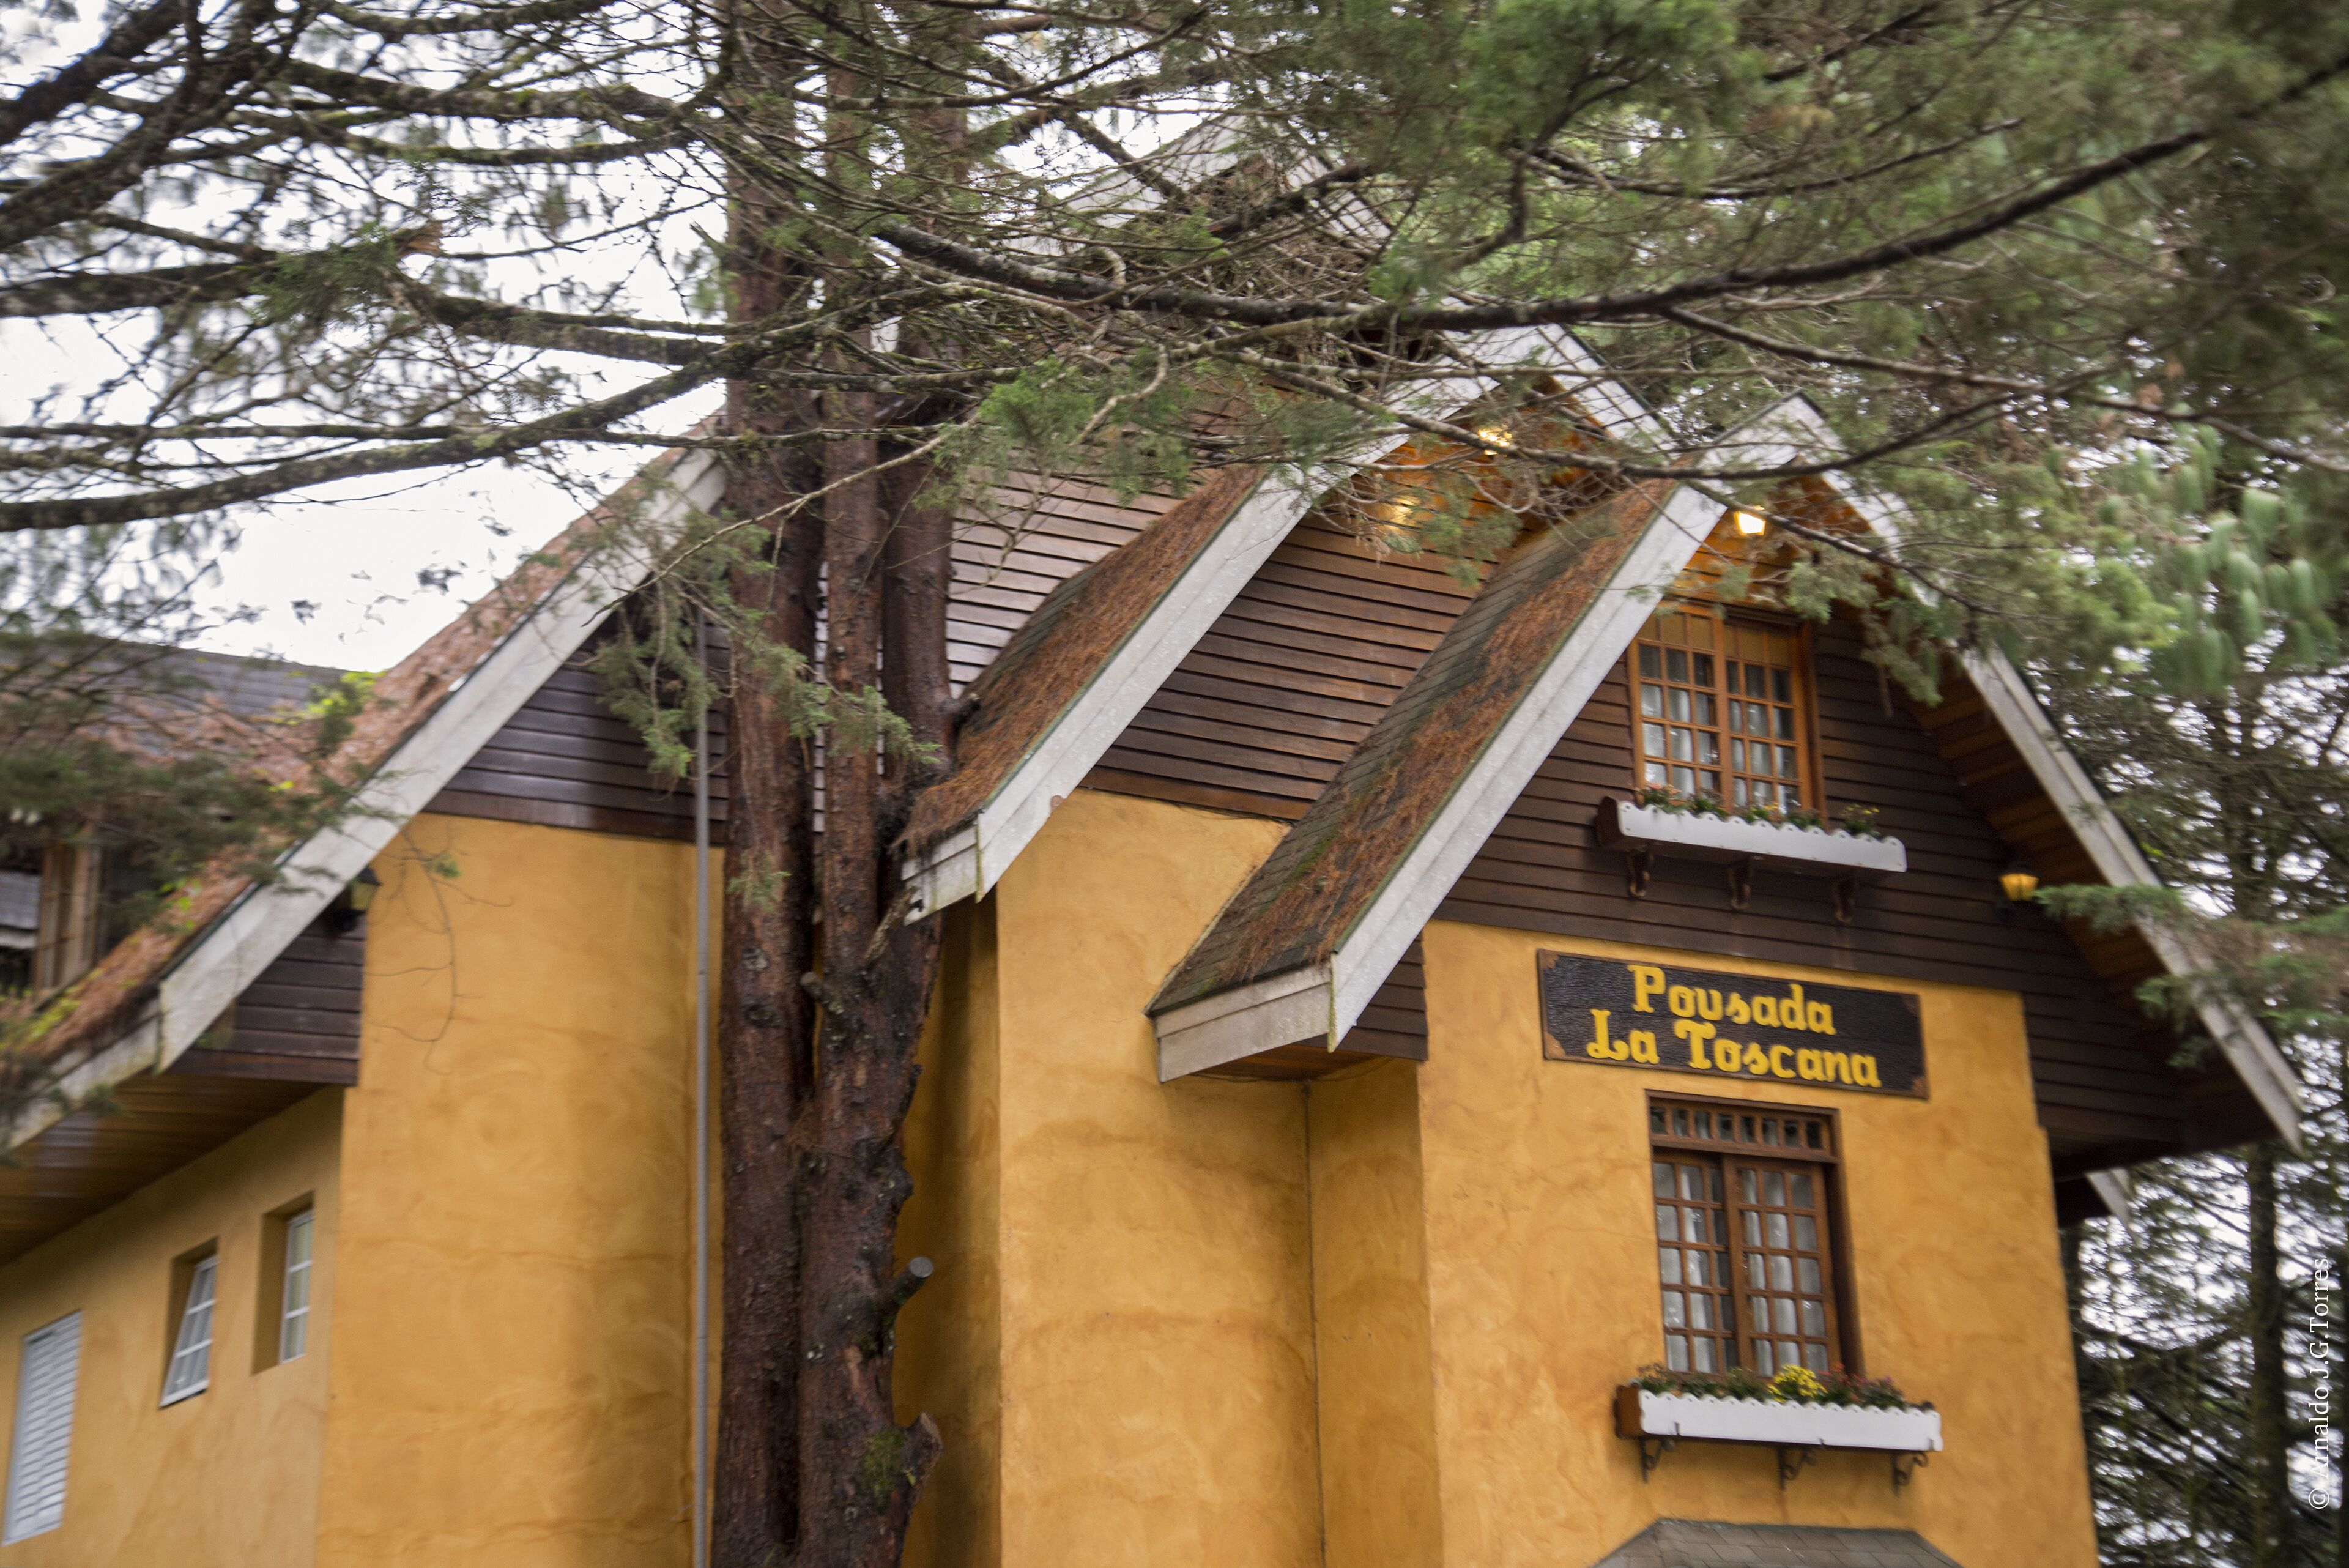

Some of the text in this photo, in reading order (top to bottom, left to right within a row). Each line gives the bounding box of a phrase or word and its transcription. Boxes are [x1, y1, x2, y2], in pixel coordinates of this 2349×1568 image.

[1627, 965, 1836, 1035] Pousada
[1586, 1009, 1882, 1088] La Toscana
